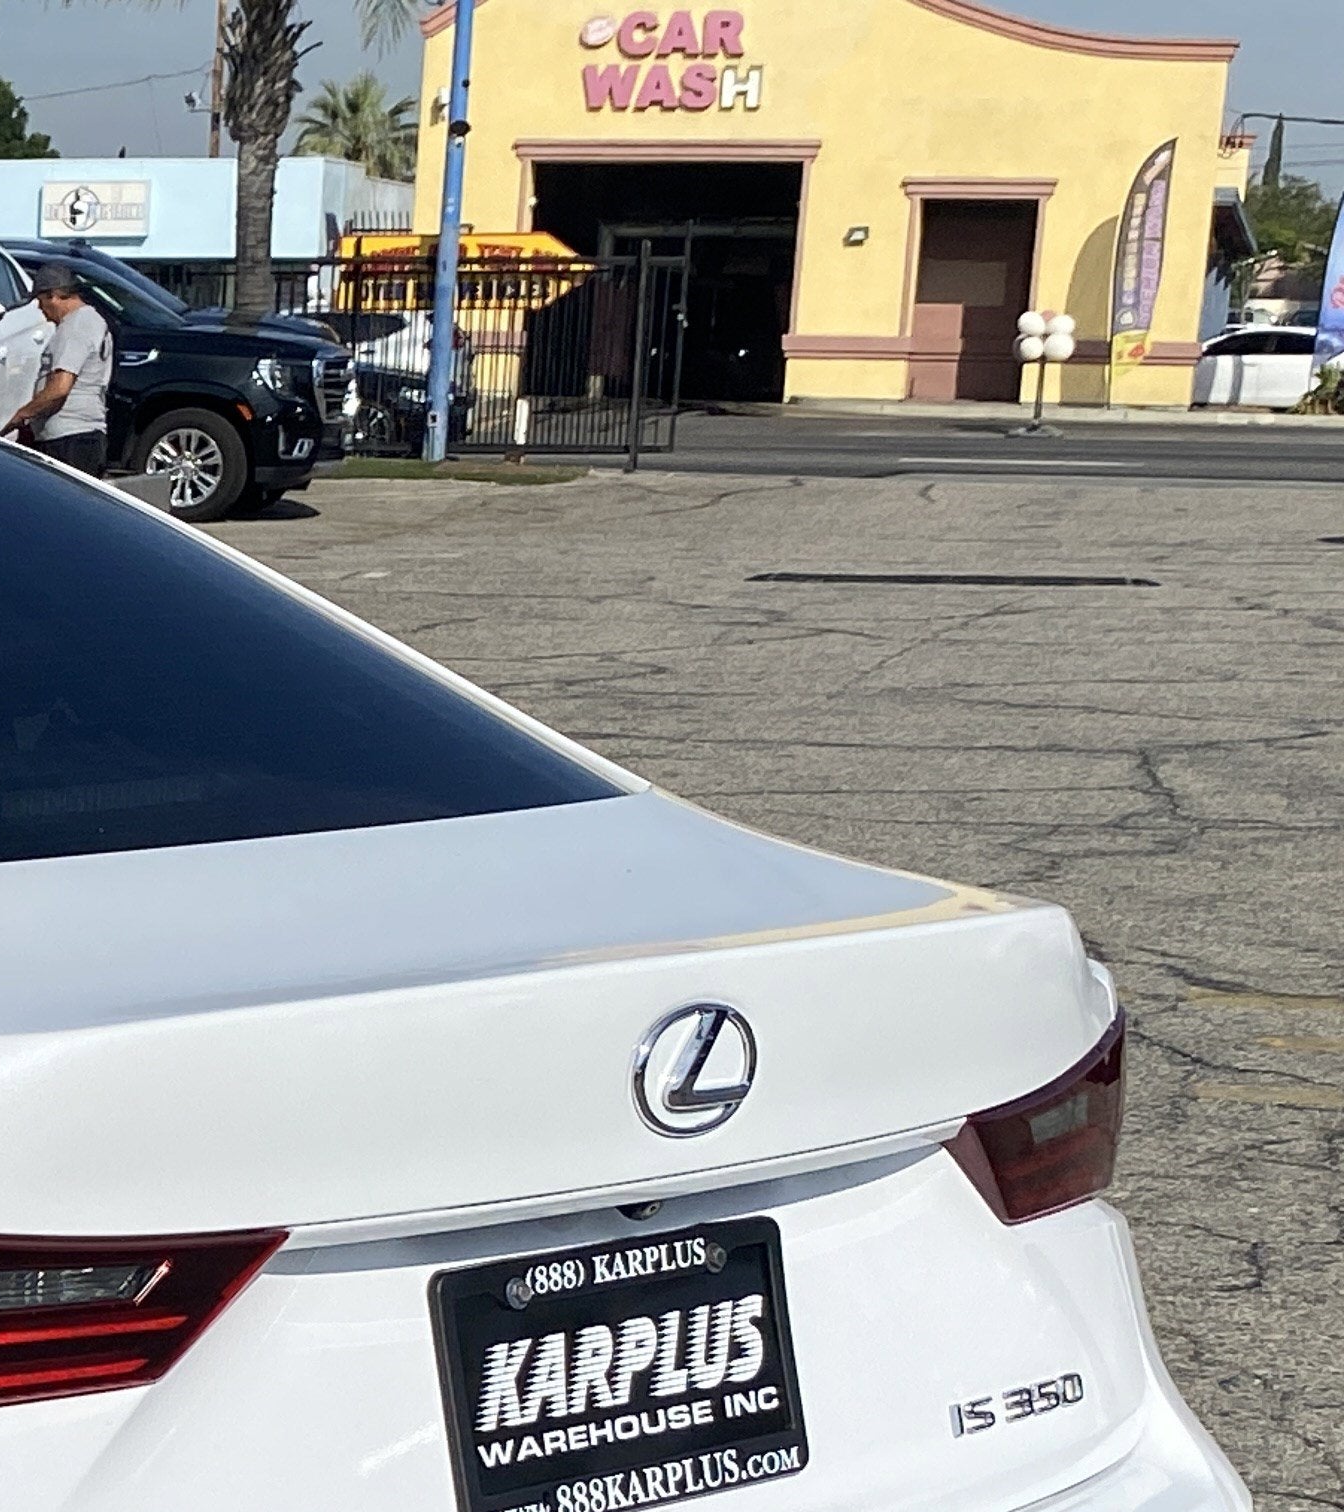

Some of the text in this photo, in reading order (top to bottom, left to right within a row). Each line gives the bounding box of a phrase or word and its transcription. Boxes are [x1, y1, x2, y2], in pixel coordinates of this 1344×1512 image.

[617, 10, 745, 59] CAR
[582, 63, 762, 112] WASH
[524, 1237, 707, 1296] (888) KARPLUS
[474, 1294, 764, 1432] KARPLUS
[477, 1386, 780, 1468] WAREHOUSE INC
[949, 1372, 1084, 1438] IS 350
